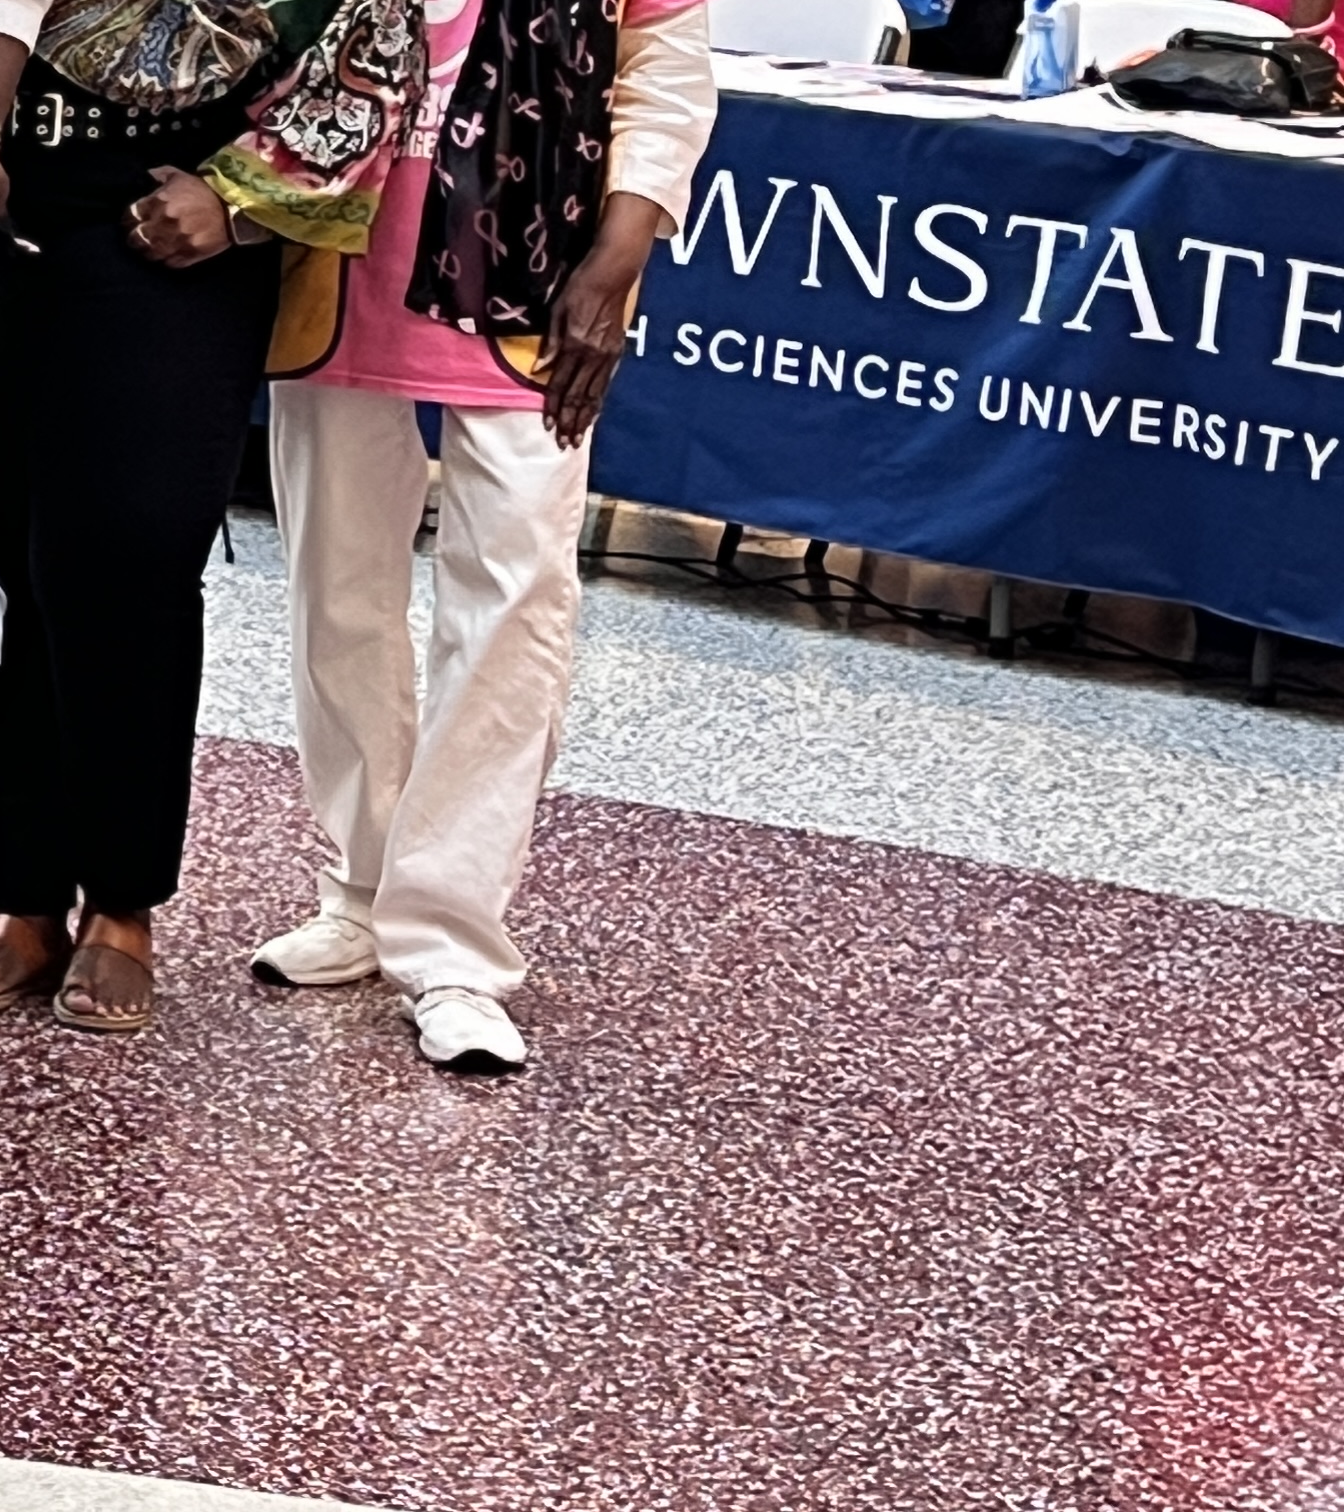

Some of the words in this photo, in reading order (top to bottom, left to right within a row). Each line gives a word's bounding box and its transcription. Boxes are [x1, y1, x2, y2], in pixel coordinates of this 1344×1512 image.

[670, 169, 1344, 378] WNSTATE
[672, 322, 960, 413] SCIENCES
[978, 375, 1339, 481] UNIVERSITY
